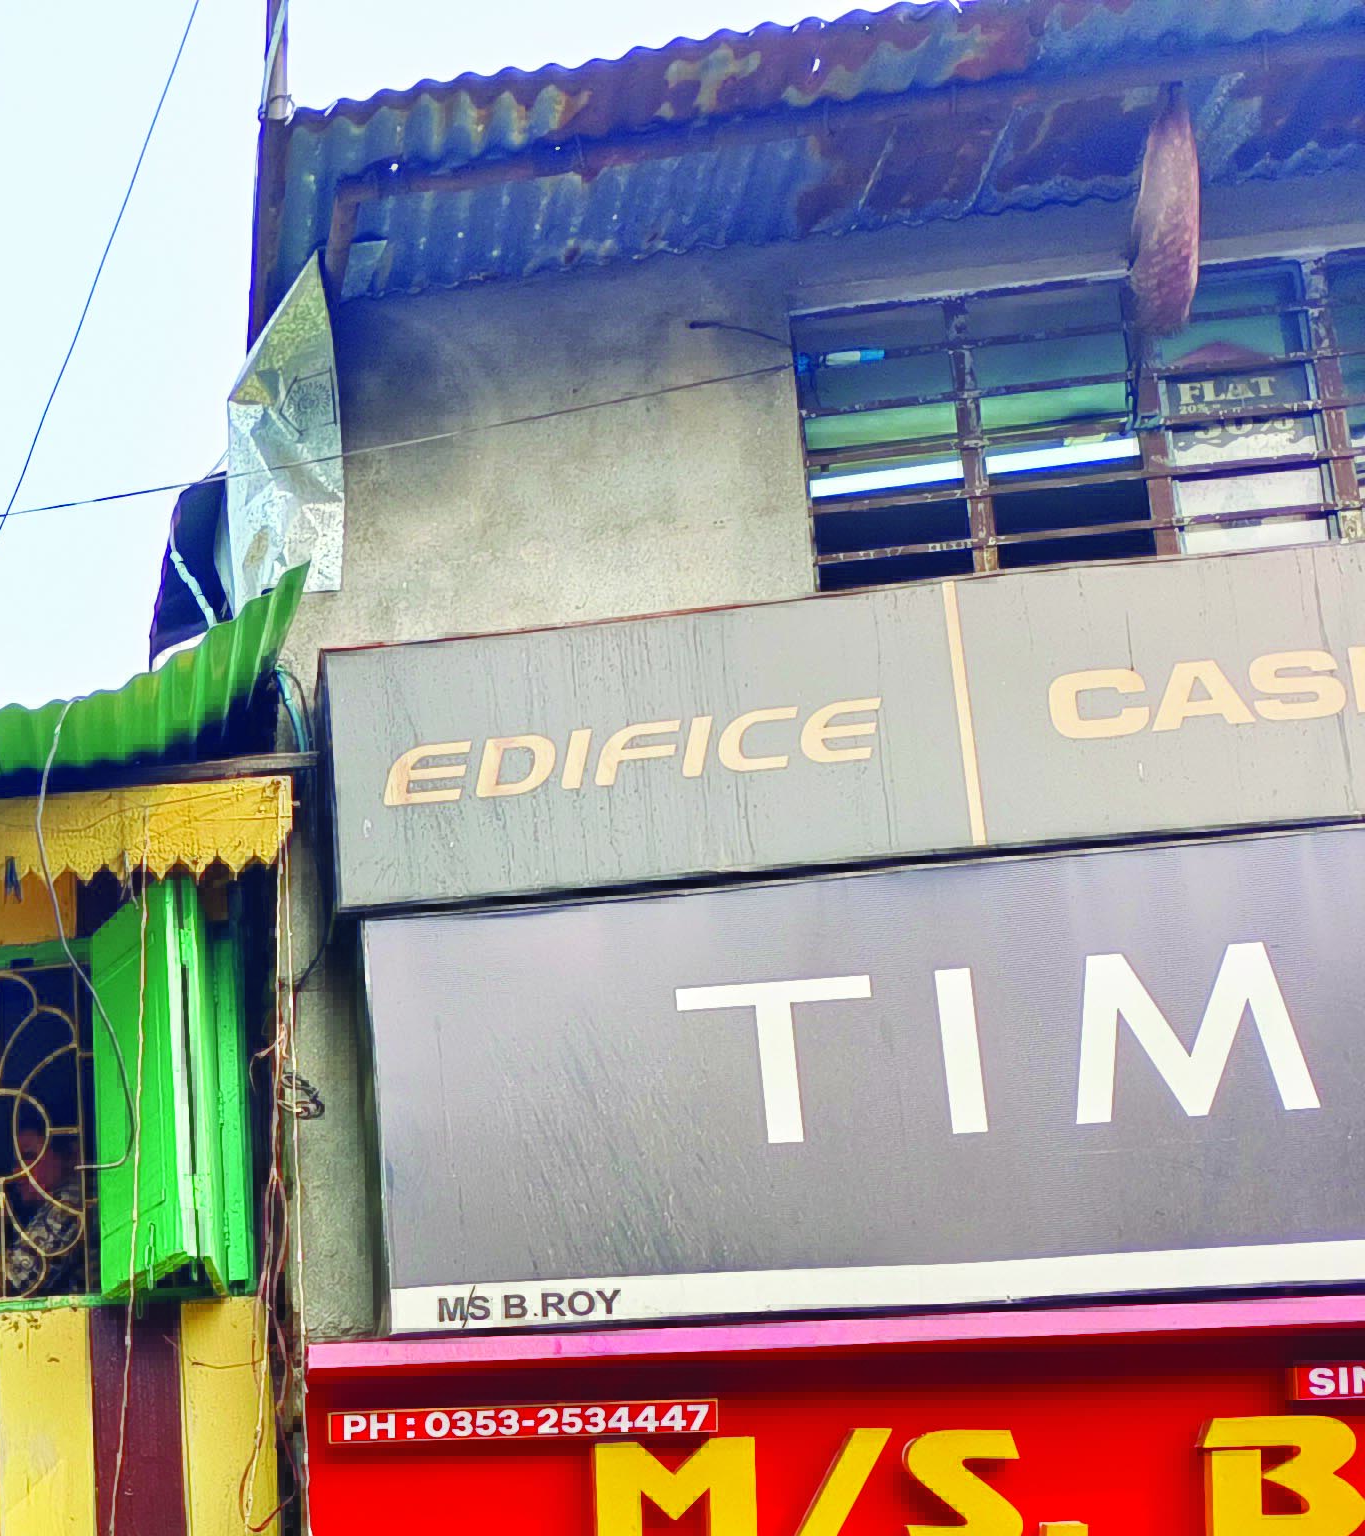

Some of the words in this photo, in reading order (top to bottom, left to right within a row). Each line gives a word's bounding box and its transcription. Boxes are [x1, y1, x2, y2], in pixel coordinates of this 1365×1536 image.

[1177, 376, 1276, 404] FLAT
[383, 697, 883, 806] EDIFICE
[675, 941, 1321, 1144] TIM
[425, 1404, 711, 1439] 0353-2534447
